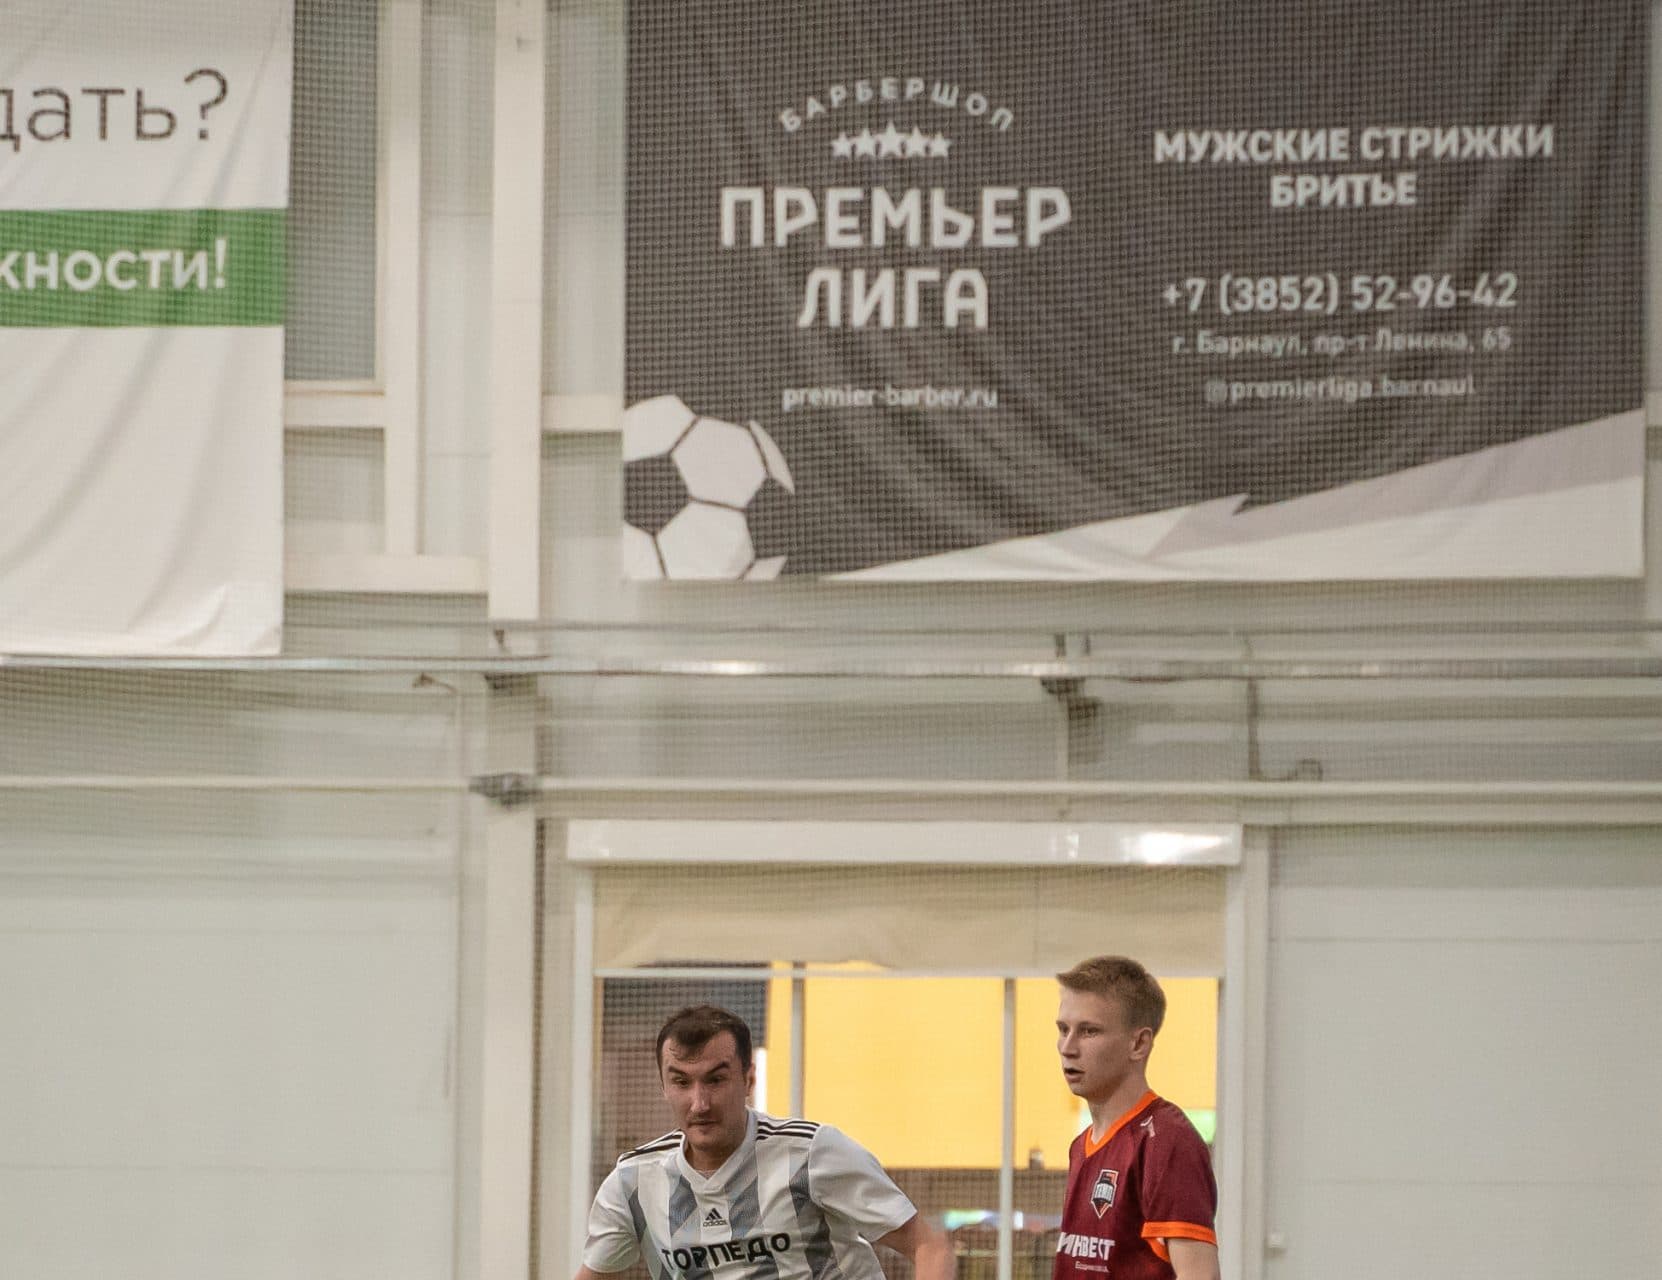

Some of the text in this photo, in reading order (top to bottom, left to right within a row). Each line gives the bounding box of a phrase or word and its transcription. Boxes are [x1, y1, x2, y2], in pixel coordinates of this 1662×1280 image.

[779, 77, 1014, 132] БАРБЕРШОП
[1153, 125, 1555, 163] МУЖСКИЕ СТРИЖКИ
[1270, 173, 1418, 208] БРИТЬЕ
[720, 186, 1072, 249] ПРЕМЬЕР
[797, 267, 989, 329] ЛИГА
[1162, 272, 1518, 315] +7 (3852) 52-96-42
[782, 384, 999, 412] premier-barber.ru
[661, 1232, 791, 1271] ТОРПЕДО
